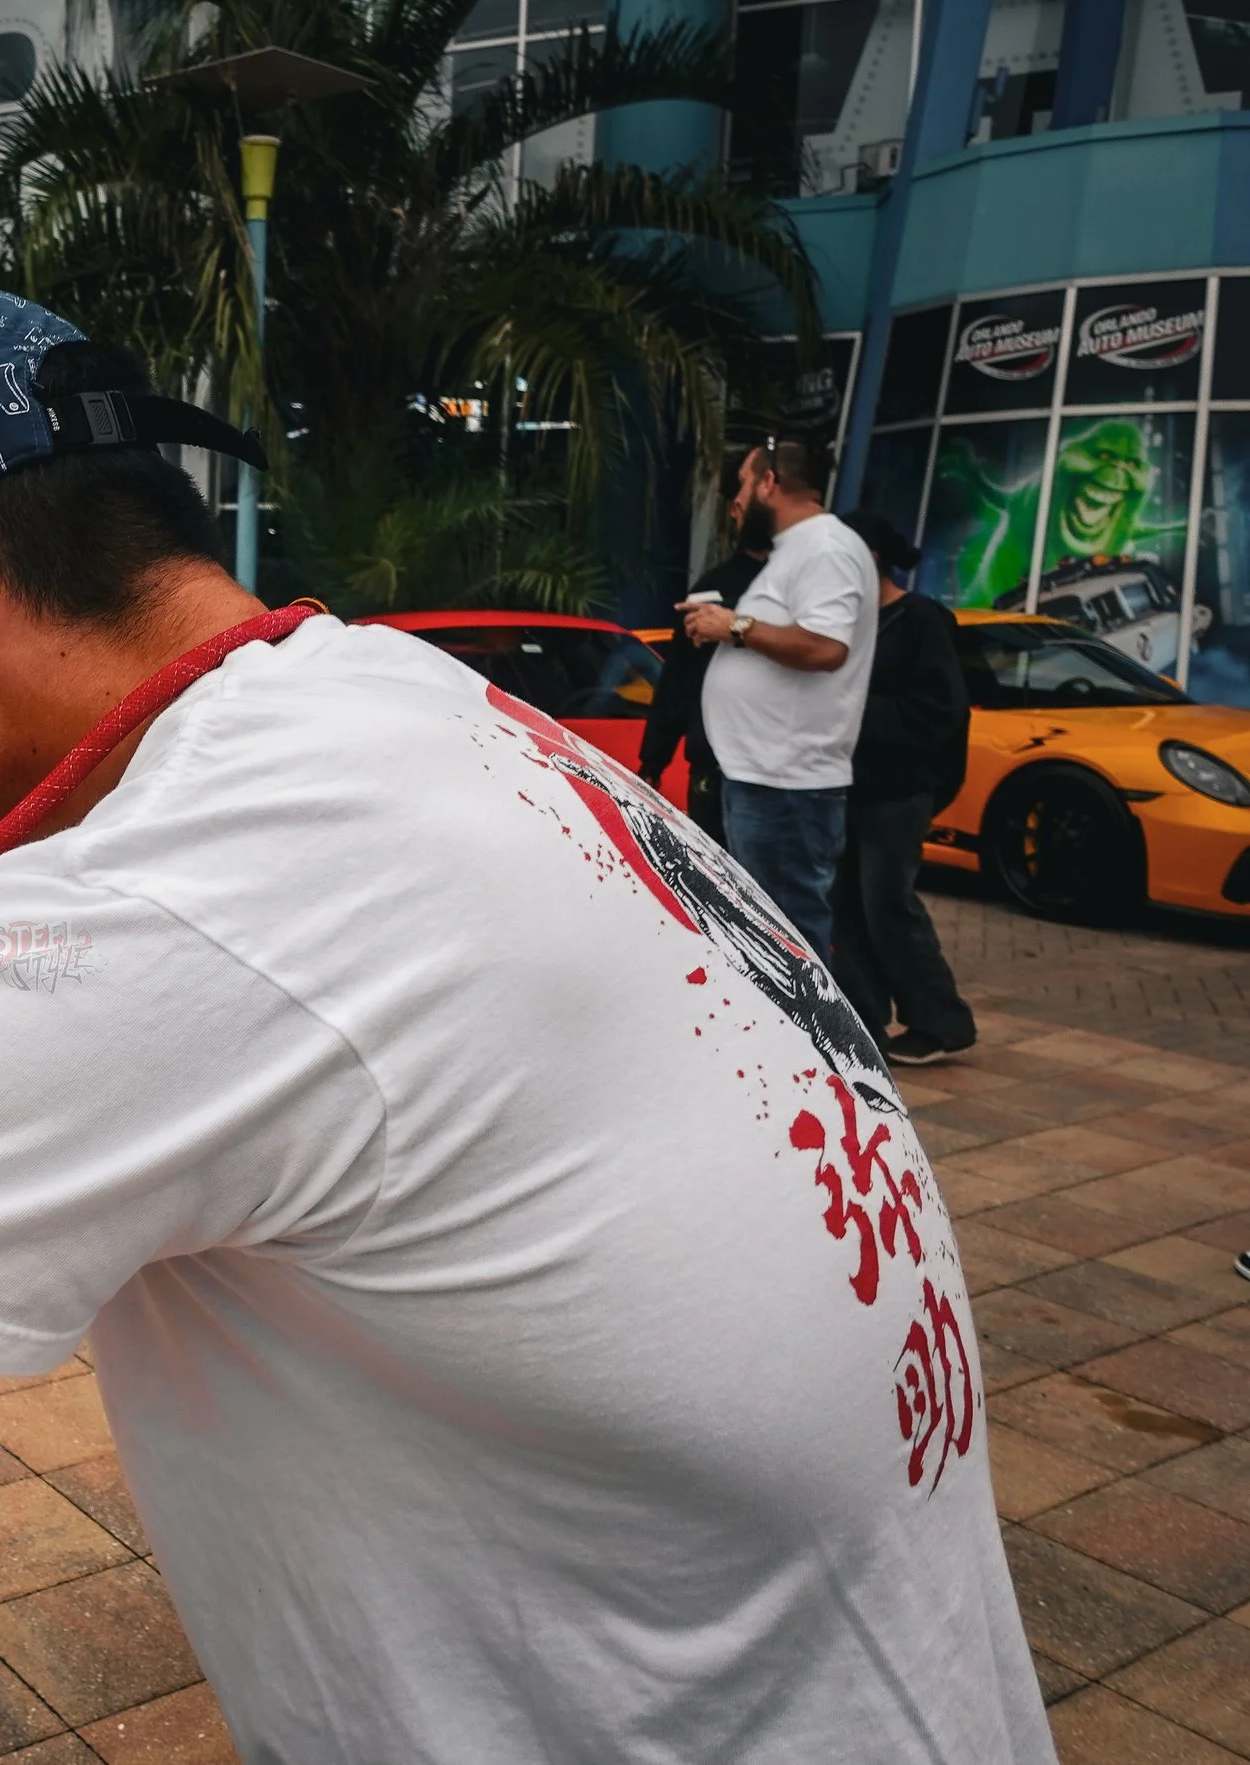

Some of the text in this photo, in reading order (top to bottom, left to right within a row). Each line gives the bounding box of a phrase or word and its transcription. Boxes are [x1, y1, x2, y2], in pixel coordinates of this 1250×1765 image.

[971, 320, 1024, 342] ORLANDO
[1077, 310, 1204, 357] AUTO MUSEUM
[1093, 307, 1158, 334] ORLANDO
[955, 327, 1060, 362] AUTO MUSEUM
[11, 943, 93, 994] STYLE
